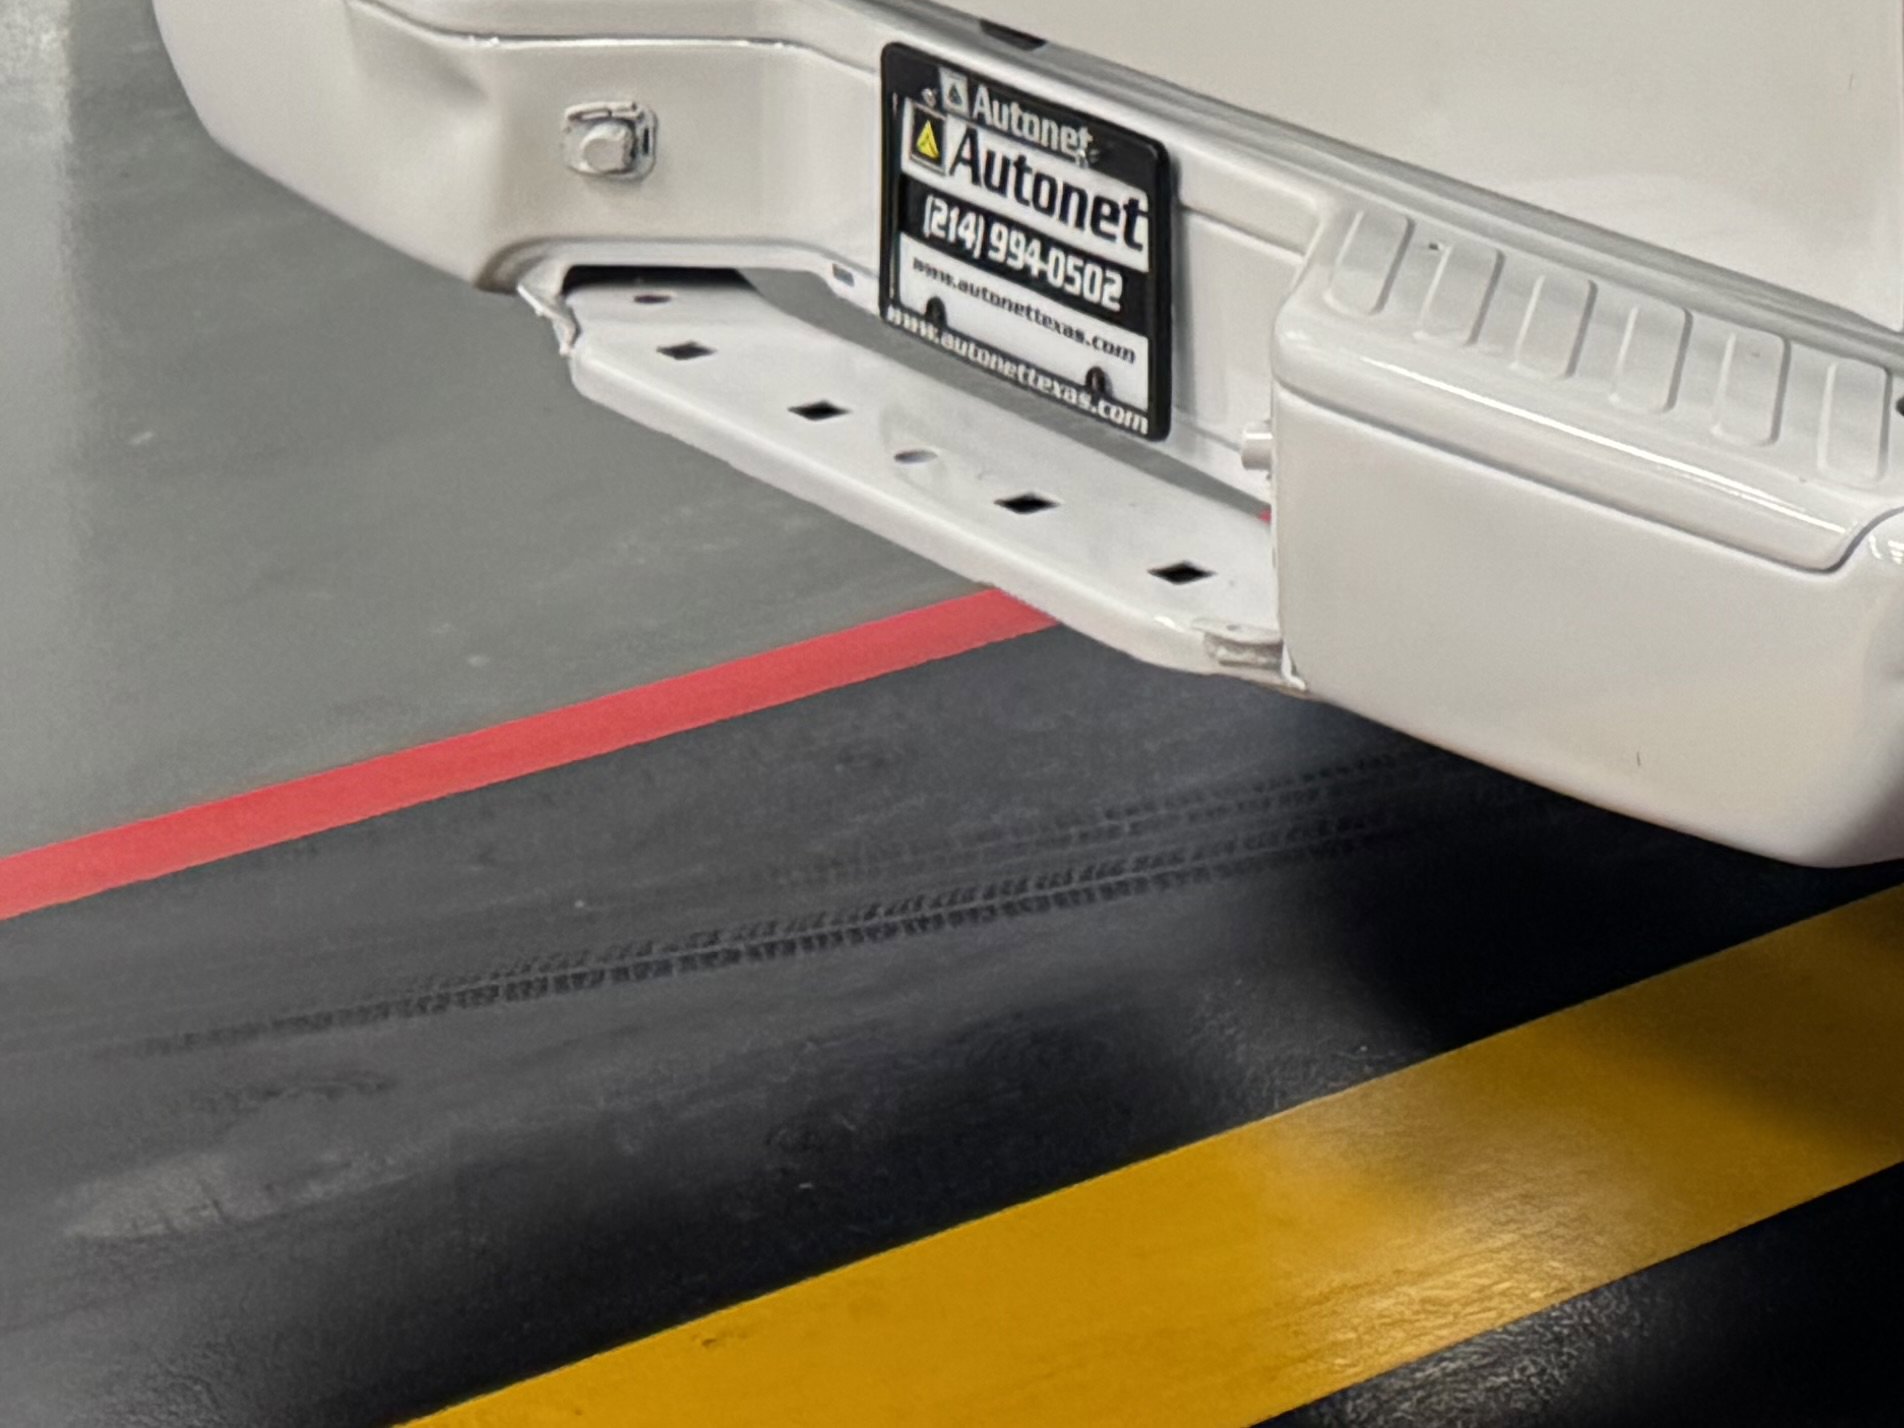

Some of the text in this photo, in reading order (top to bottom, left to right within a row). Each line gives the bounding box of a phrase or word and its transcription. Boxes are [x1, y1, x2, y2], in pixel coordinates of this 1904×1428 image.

[971, 83, 1095, 164] Autonet
[948, 127, 1149, 253] Autonet
[911, 254, 1137, 364] www.autonettexas.com
[922, 193, 1125, 313] (214) 994-0502
[887, 304, 1149, 435] www.autonettexas.com
